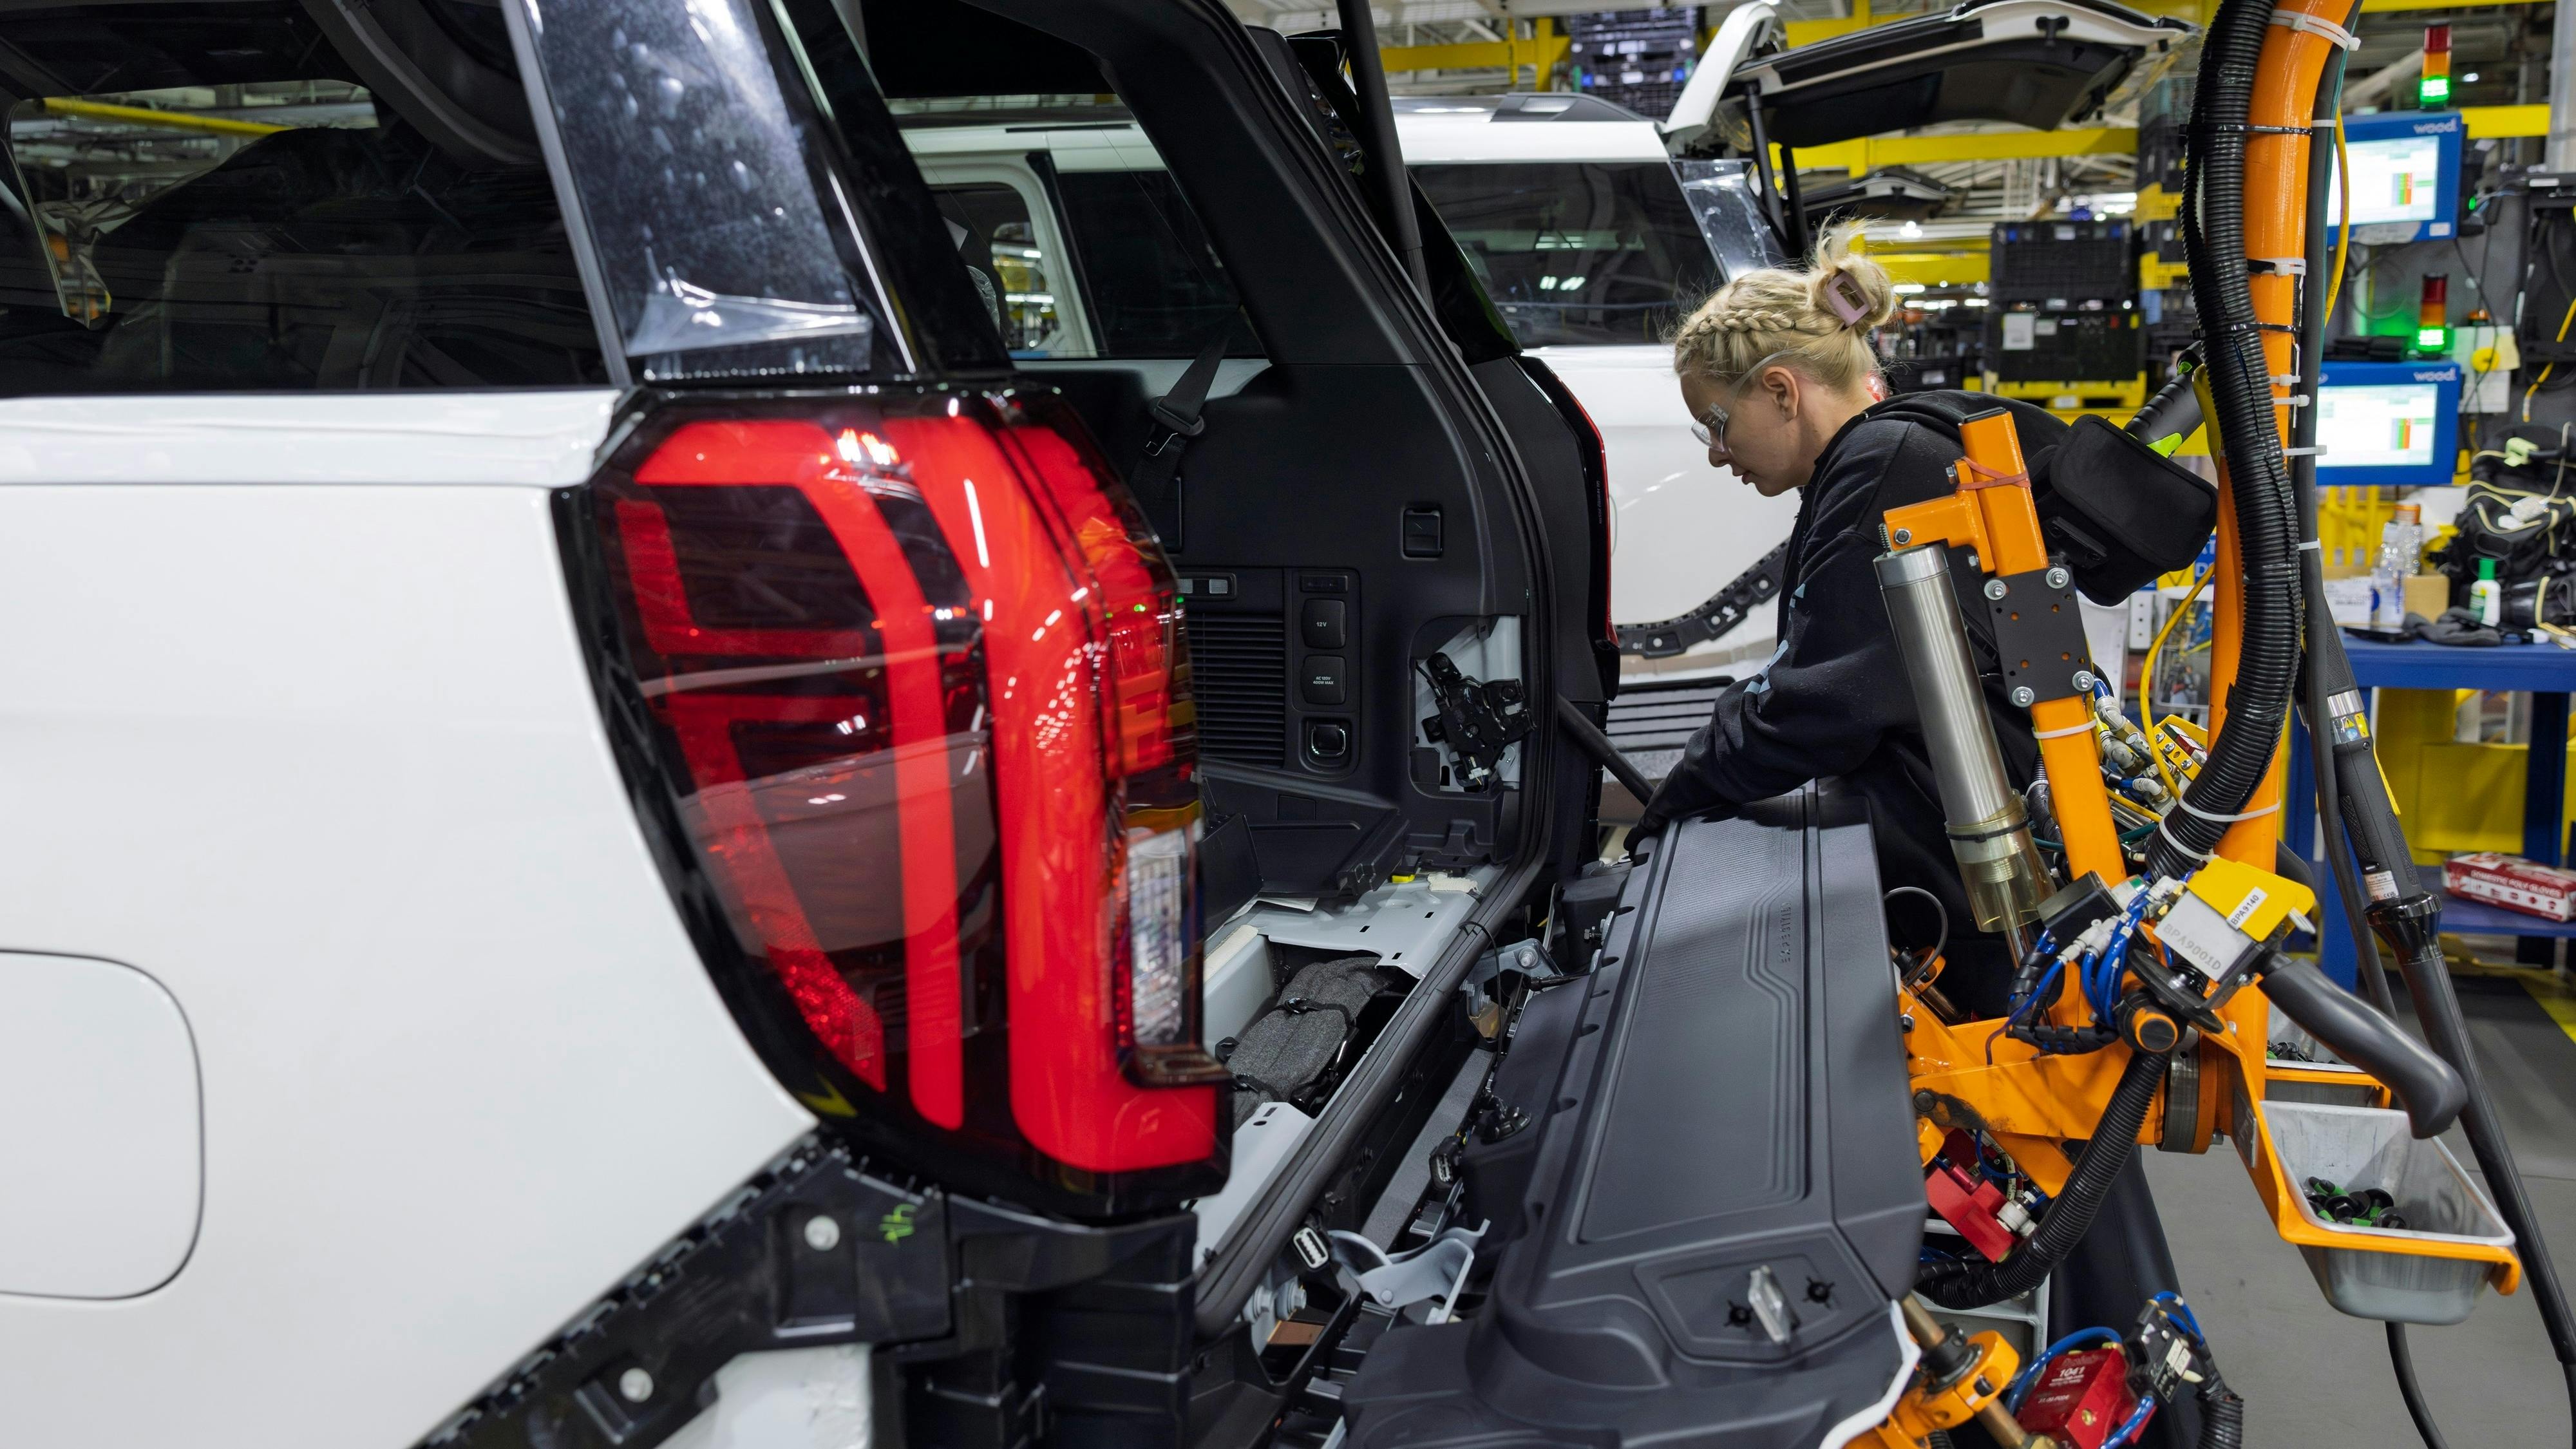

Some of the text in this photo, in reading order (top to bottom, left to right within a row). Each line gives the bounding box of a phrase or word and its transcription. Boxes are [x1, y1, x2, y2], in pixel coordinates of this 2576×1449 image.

[2470, 869, 2562, 898] DOMESTIC POLY GLOVES
[2231, 895, 2259, 925] BPA9140
[2163, 923, 2222, 971] BPA9001D
[2059, 1366, 2086, 1378] 1041
